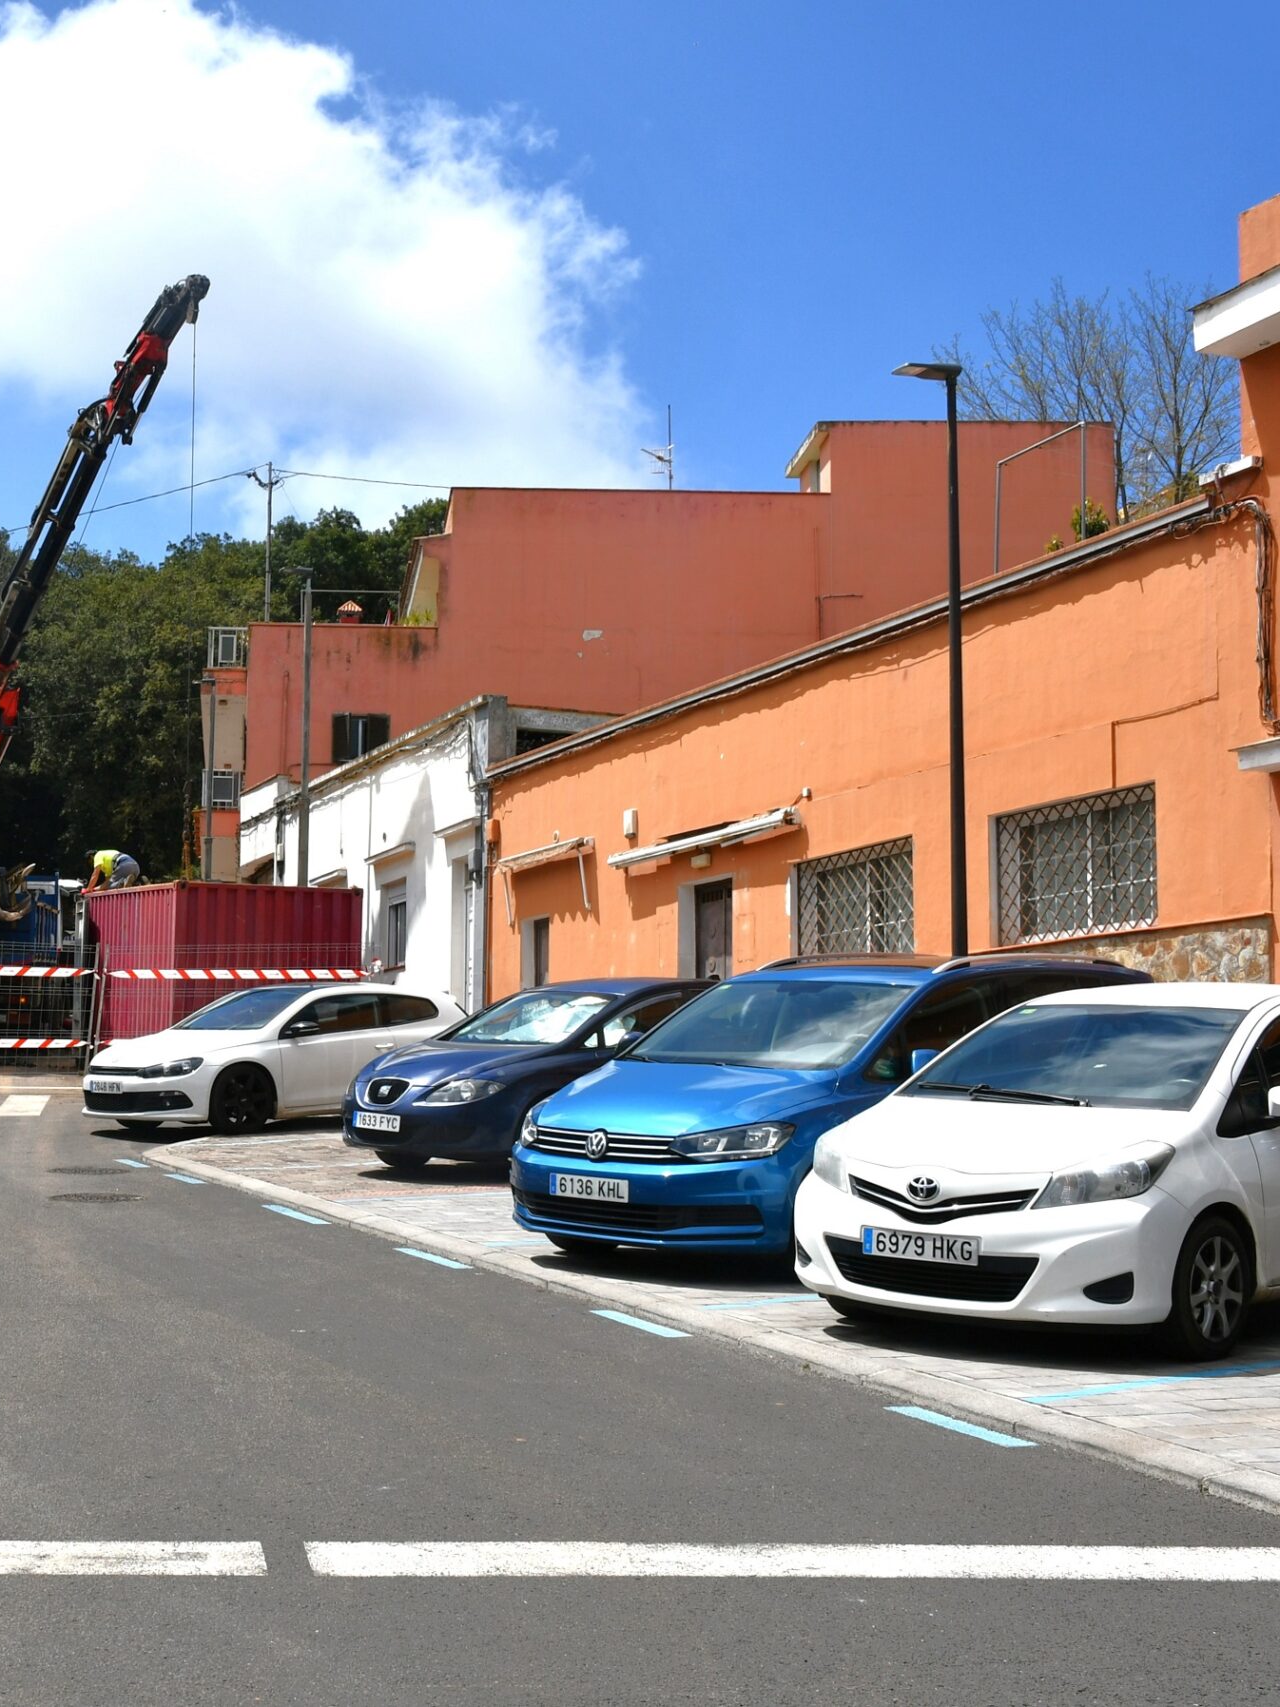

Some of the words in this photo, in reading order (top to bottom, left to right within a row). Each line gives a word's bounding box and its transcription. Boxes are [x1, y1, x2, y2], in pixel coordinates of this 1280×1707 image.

[358, 1113, 377, 1127] 1633
[379, 1115, 398, 1130] FYC
[559, 1176, 593, 1196] 6136
[598, 1180, 625, 1200] KHL
[875, 1232, 925, 1257] 6979
[932, 1236, 973, 1261] HKG
